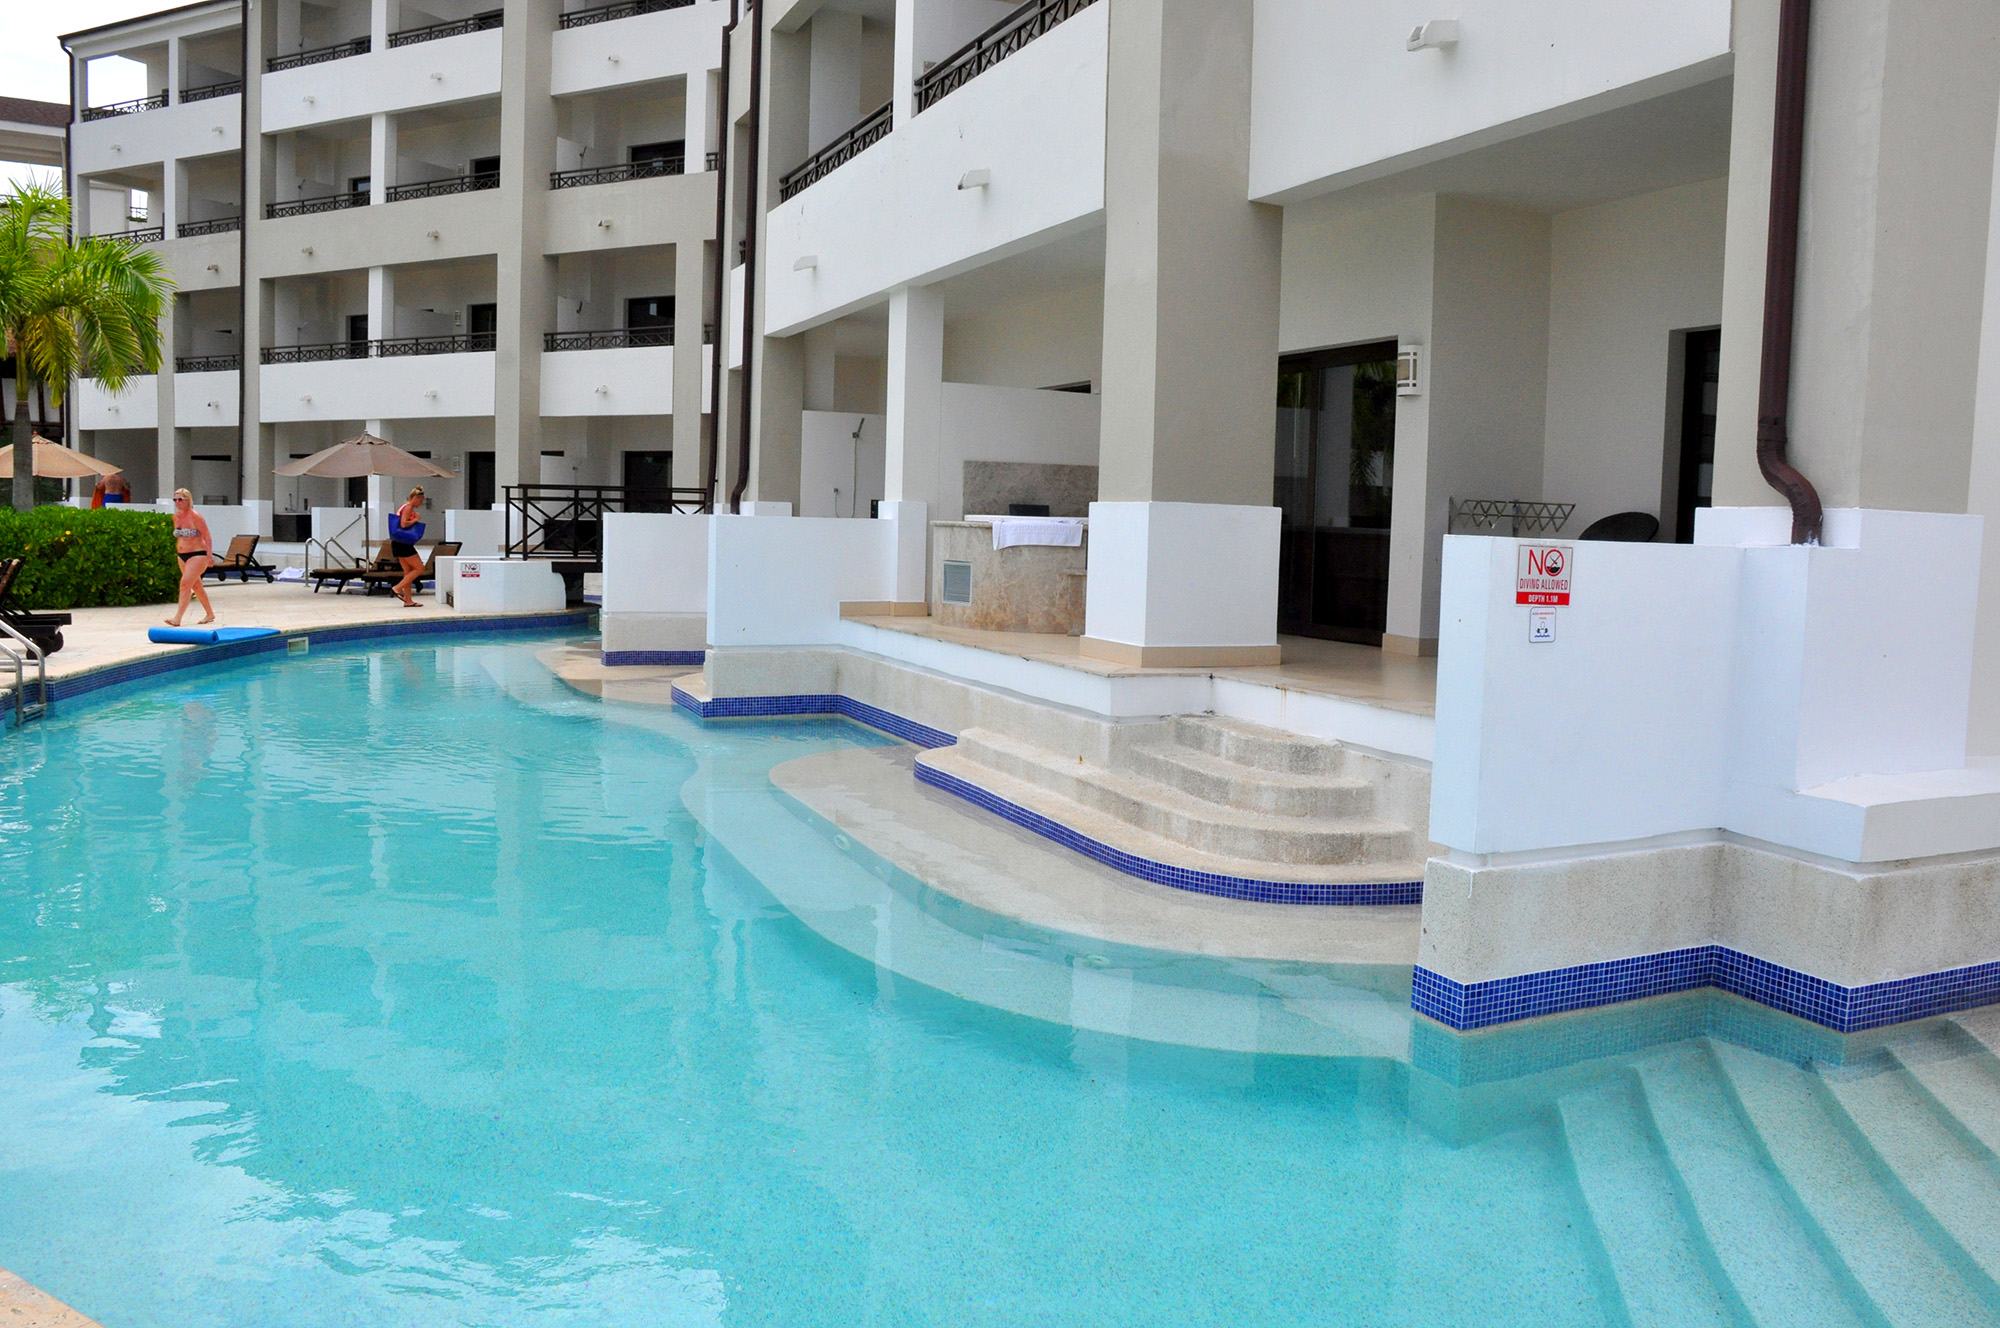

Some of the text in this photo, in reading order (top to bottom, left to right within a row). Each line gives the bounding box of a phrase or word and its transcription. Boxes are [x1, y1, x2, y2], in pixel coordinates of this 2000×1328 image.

[1528, 549, 1564, 577] NO
[1520, 578, 1569, 590] DIVING ALLOWED
[1528, 594, 1558, 603] DEPTH 1.1M
